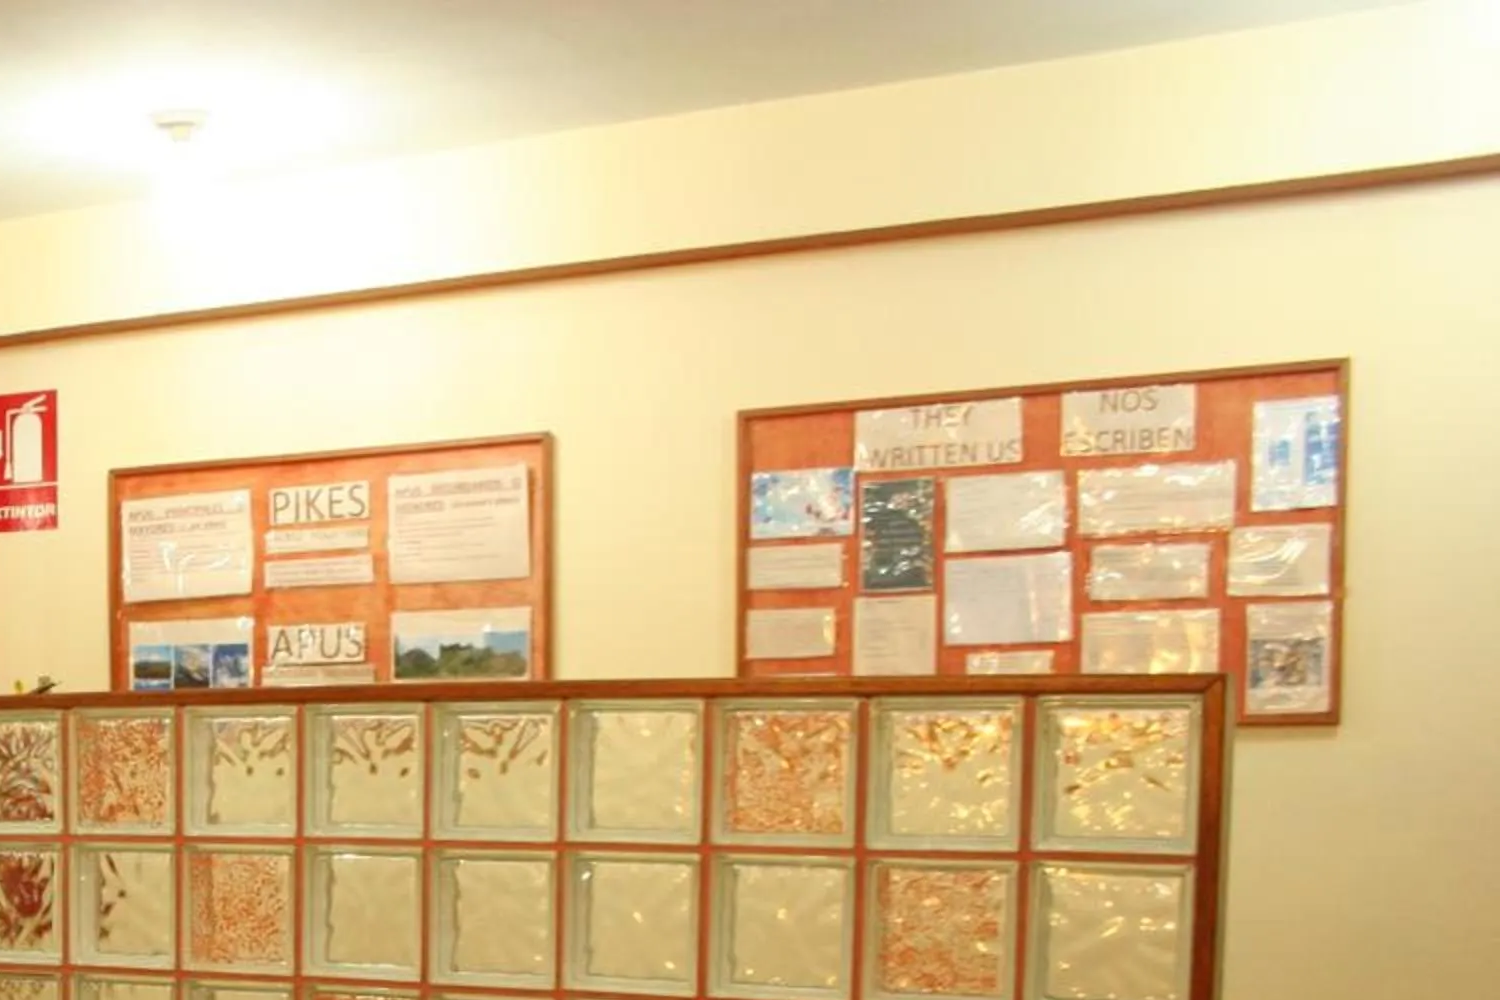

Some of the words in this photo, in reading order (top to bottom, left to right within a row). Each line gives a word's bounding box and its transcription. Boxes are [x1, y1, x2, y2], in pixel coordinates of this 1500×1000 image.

[1100, 388, 1159, 413] NOS
[909, 405, 973, 429] THEY
[862, 442, 978, 468] WRITTEN
[987, 438, 1020, 462] US
[1064, 427, 1192, 454] ESCRIBEN
[273, 484, 366, 525] PIKES
[271, 624, 363, 662] APUS
